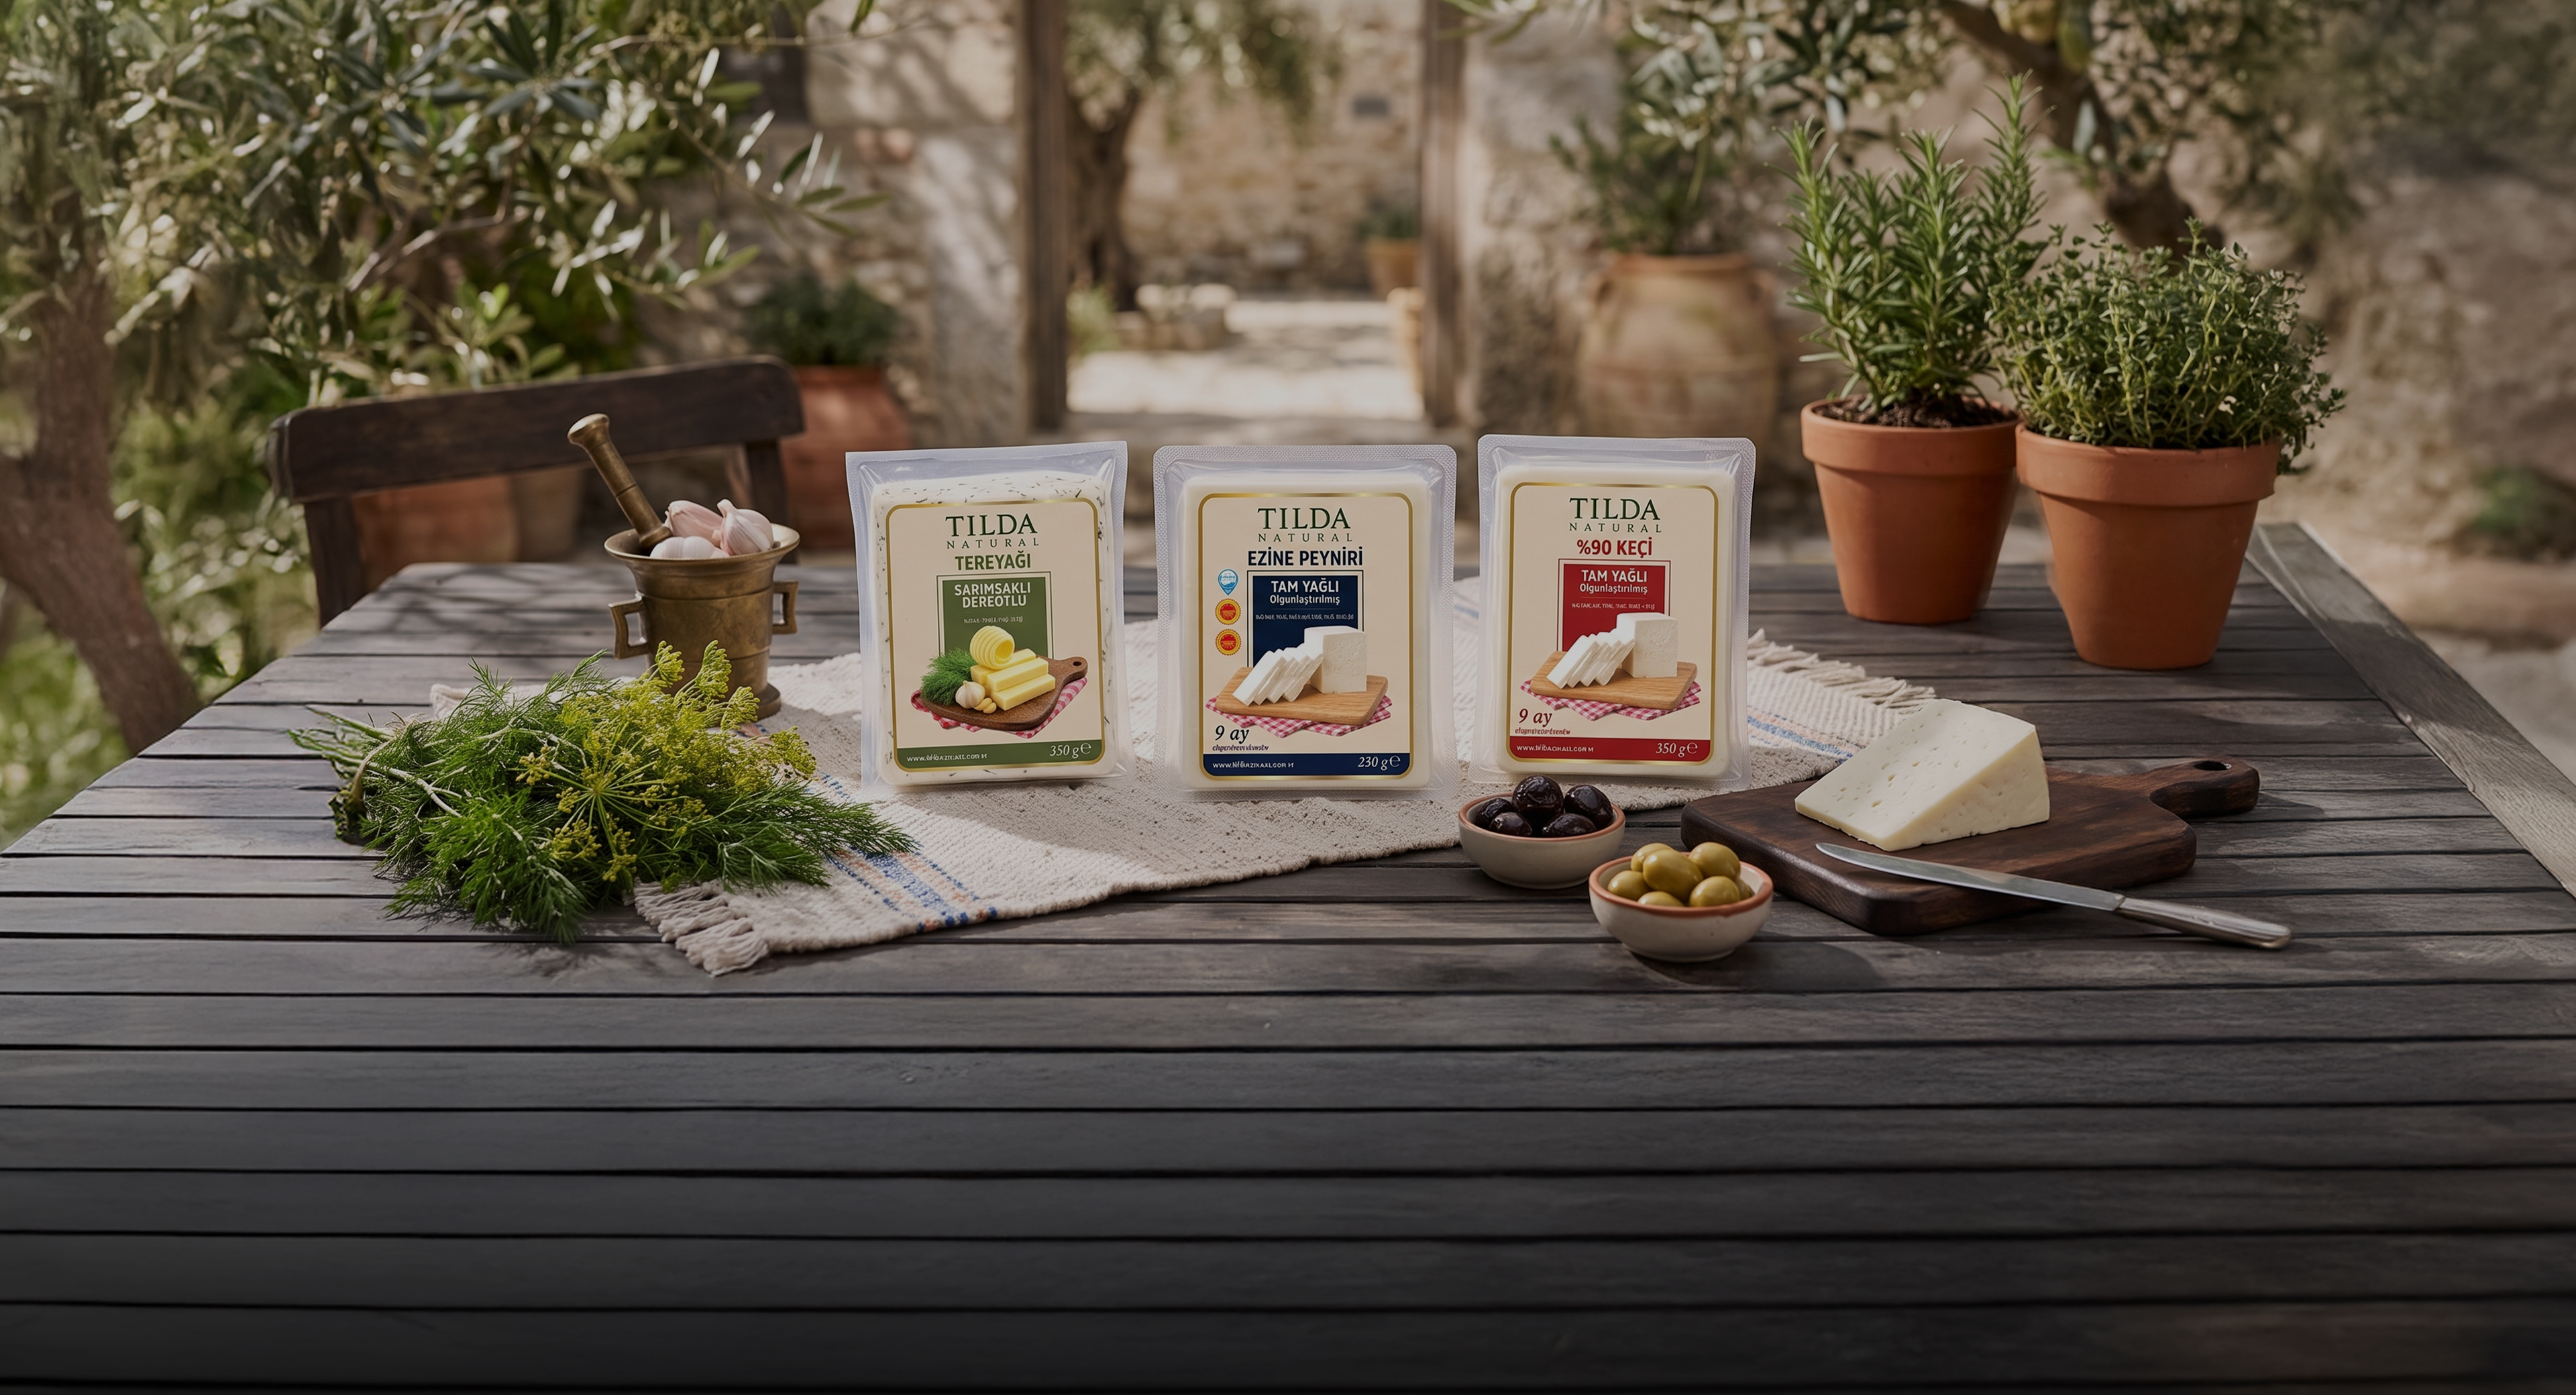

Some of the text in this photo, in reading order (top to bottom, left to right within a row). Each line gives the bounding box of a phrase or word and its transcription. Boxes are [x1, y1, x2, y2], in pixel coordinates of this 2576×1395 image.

[1569, 498, 1660, 520] TILDA
[945, 513, 1038, 537] TILDA
[1257, 508, 1351, 529] TILDA
[1569, 522, 1662, 533] NATURAL
[947, 538, 1039, 549] NATURAL
[1258, 533, 1352, 543] NATURAL
[1576, 537, 1652, 558] %90 KEÇİ
[955, 550, 1031, 570] TEREYAĞI
[1248, 546, 1362, 566] EZİNE PEYNİRİ
[1581, 568, 1648, 583] TAM YAĞLI
[955, 582, 1031, 596] SARIMSAKLI
[1271, 577, 1339, 593] TAM YAĞLI
[1580, 583, 1648, 595] Olgunlaştırılmış
[963, 595, 1027, 608] DEREOTLU
[1269, 594, 1340, 606] Olgunlaştırılmış
[1518, 708, 1553, 728] 9 ay
[1214, 725, 1250, 744] 9 ay
[1050, 744, 1070, 757] 350
[1656, 742, 1676, 754] 350
[1358, 756, 1379, 768] 230
